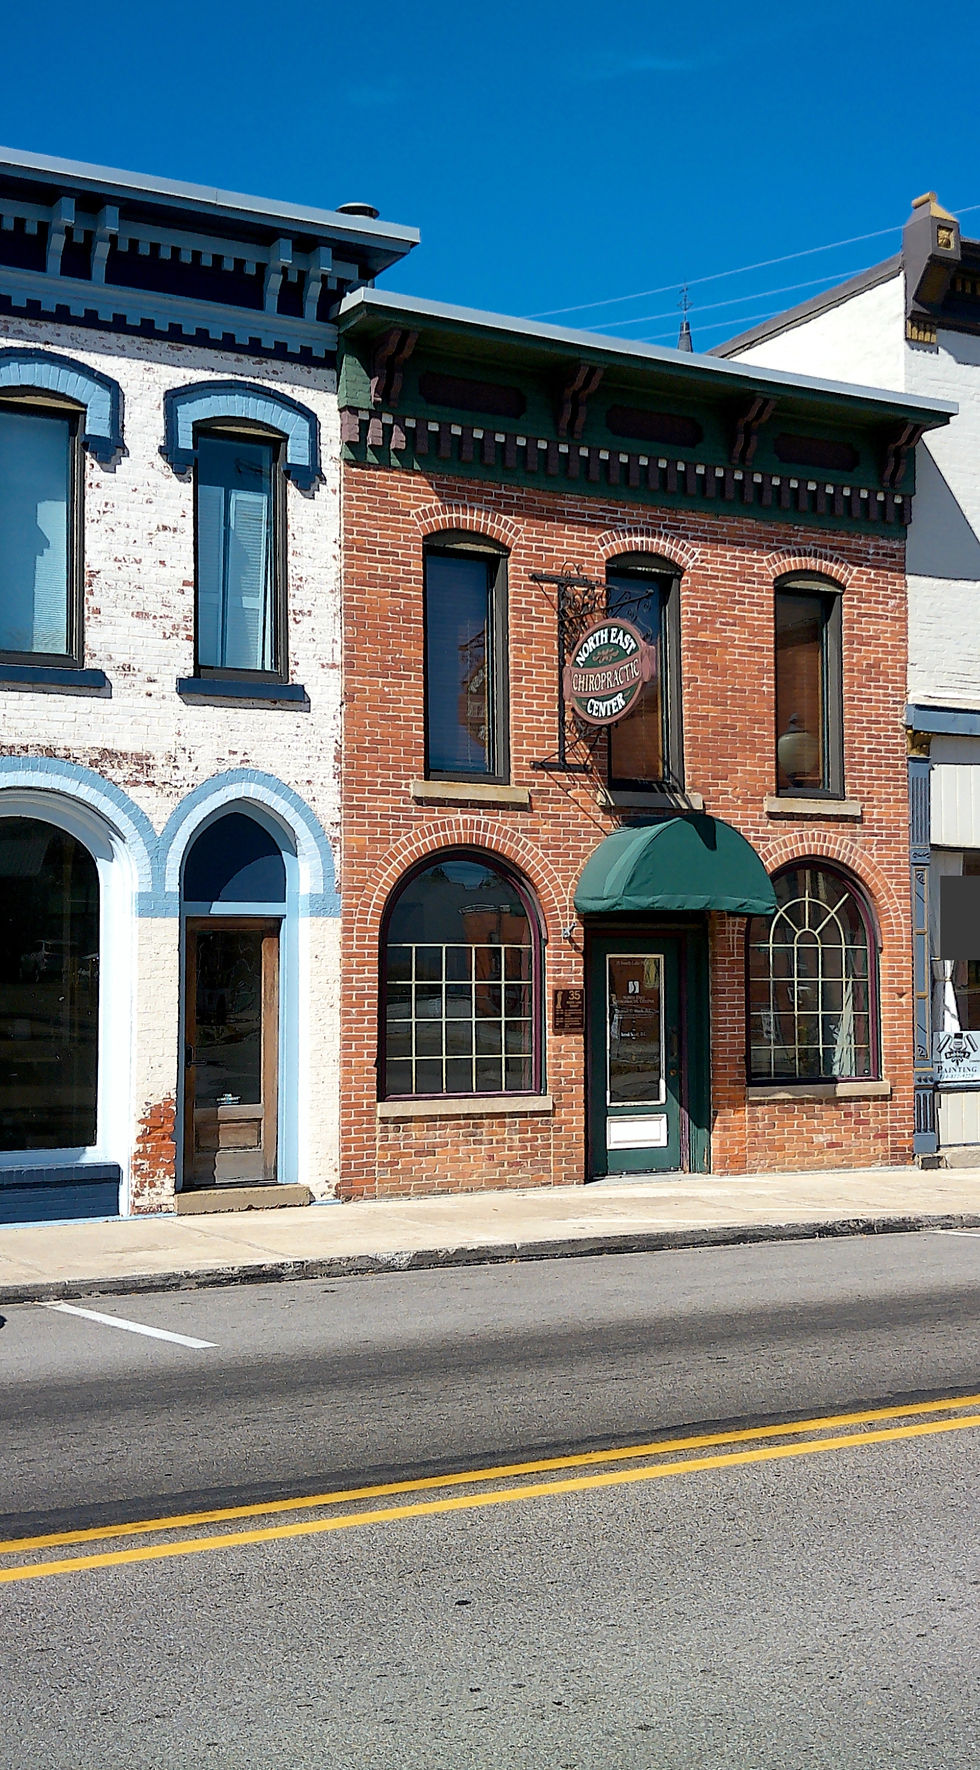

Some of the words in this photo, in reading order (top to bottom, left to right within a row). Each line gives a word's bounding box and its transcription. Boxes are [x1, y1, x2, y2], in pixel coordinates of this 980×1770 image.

[576, 628, 608, 667] NORTH
[610, 627, 637, 655] EAST
[573, 659, 640, 692] CHIROPRACTIC
[587, 692, 626, 717] CENTER
[568, 990, 581, 1000] 35
[937, 1065, 977, 1074] PAINTING
